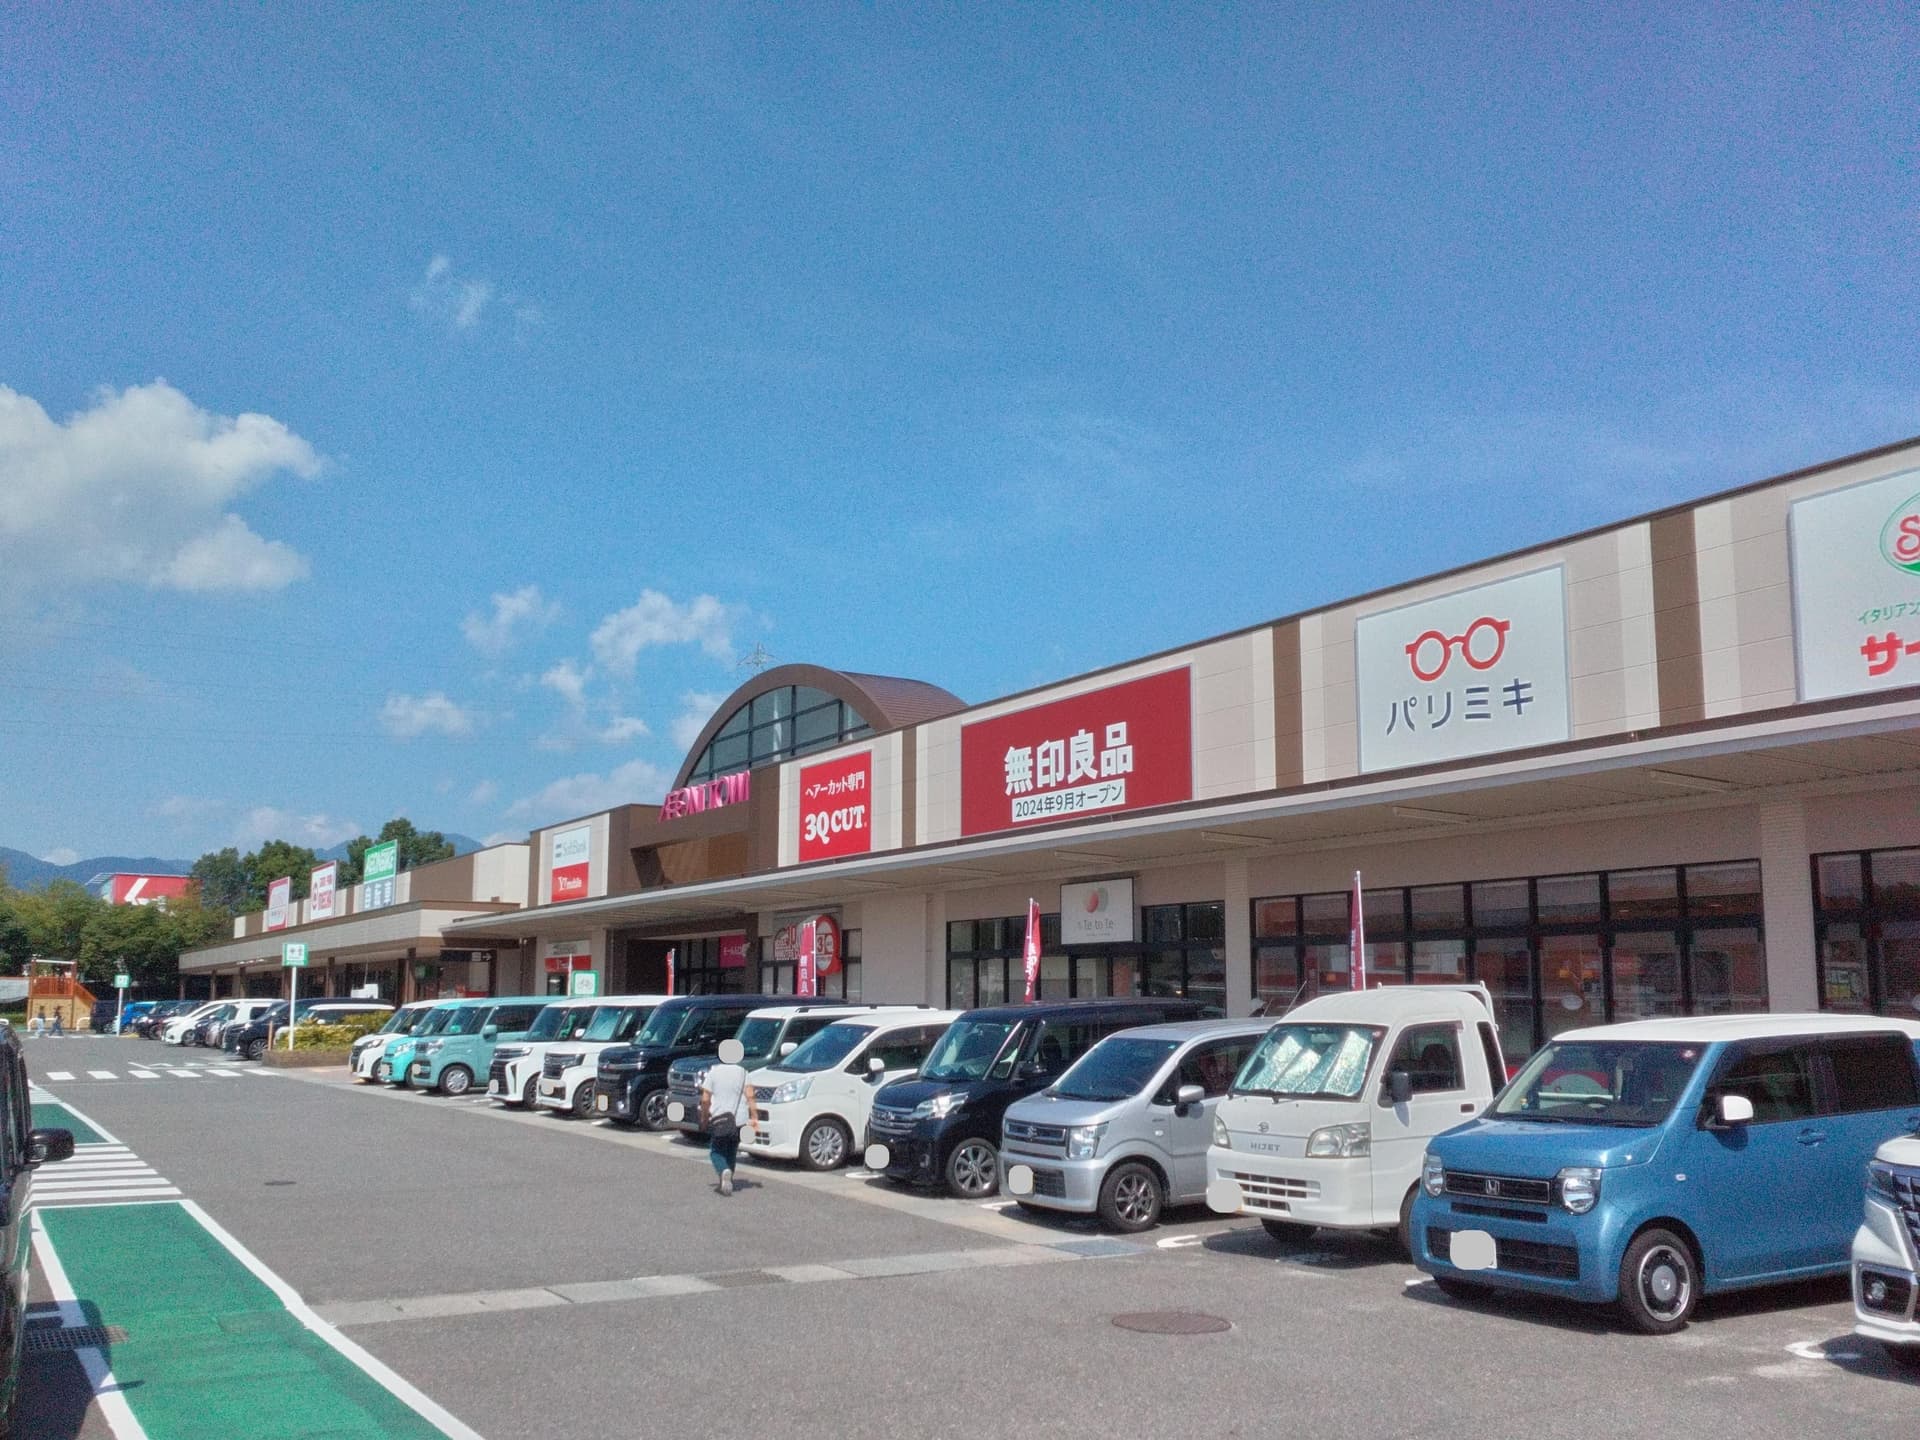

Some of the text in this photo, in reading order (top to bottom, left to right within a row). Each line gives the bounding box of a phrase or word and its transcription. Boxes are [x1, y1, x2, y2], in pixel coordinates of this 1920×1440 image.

[1387, 678, 1534, 736] パリミキ
[1004, 721, 1133, 796] 無印良品
[805, 770, 865, 799] ヘアーカット専門
[1015, 784, 1122, 818] 2024年9月オープン
[1250, 1142, 1280, 1151] HIJET
